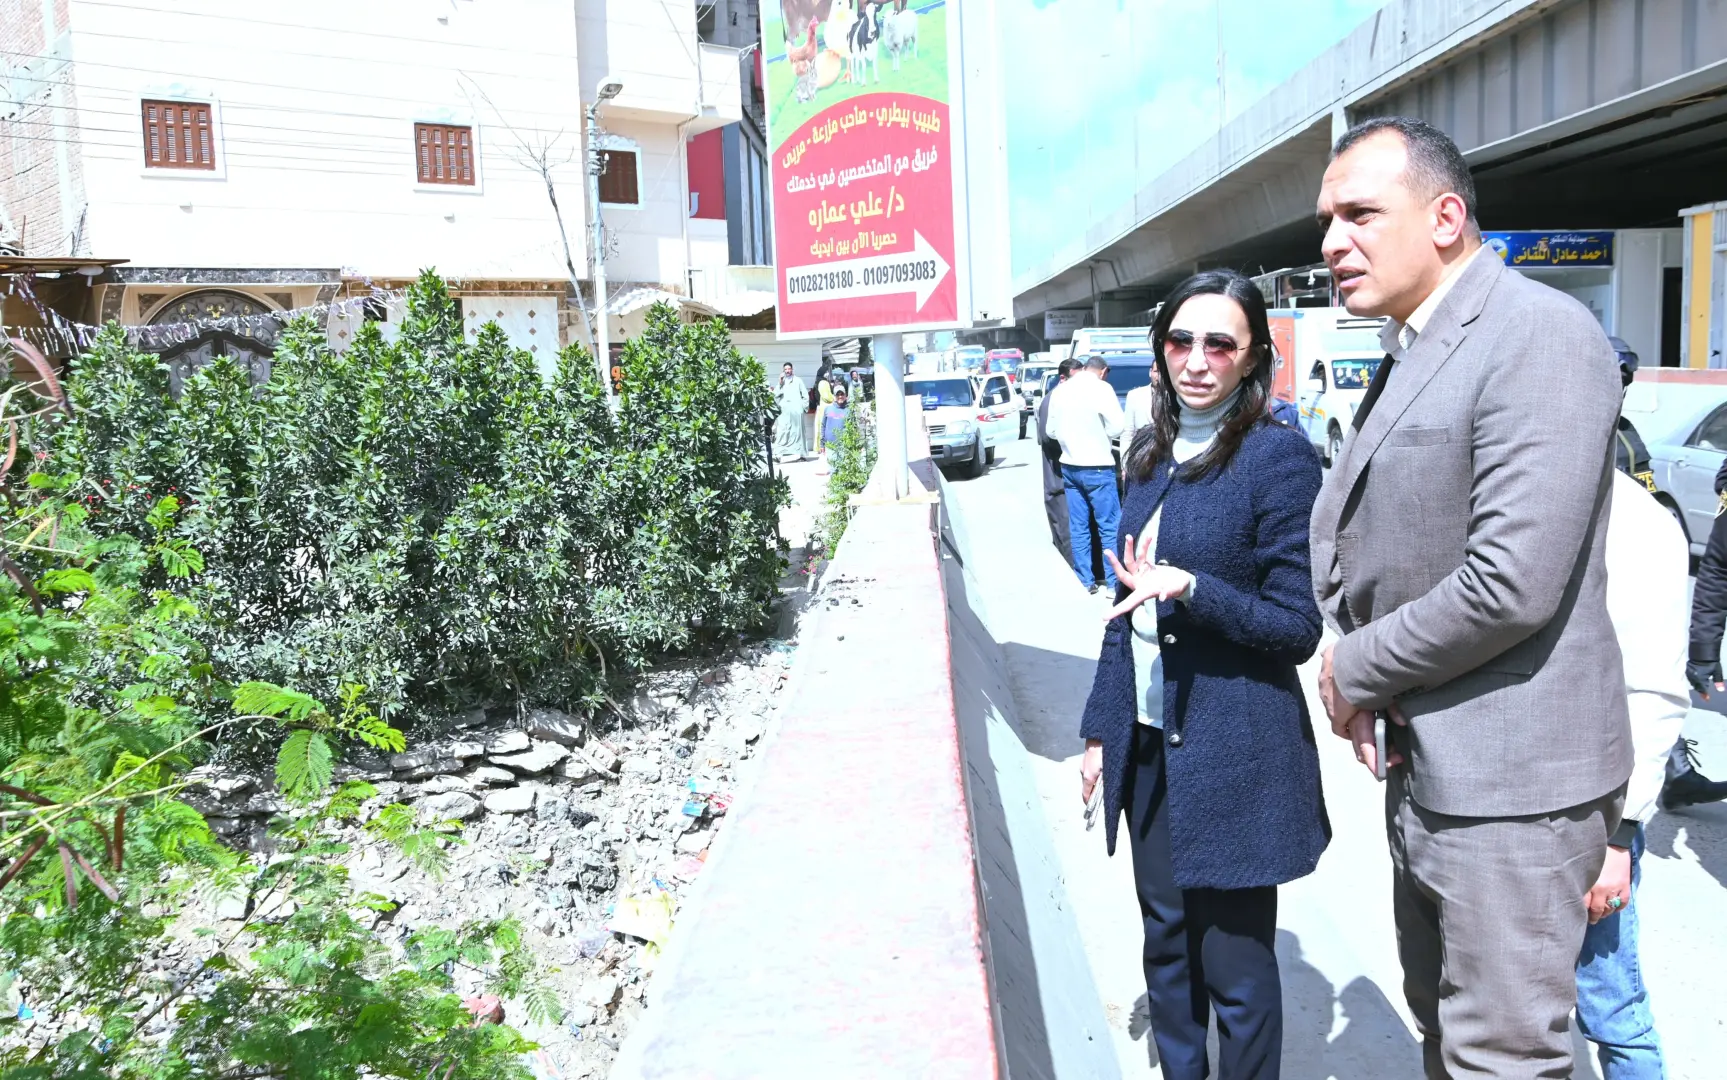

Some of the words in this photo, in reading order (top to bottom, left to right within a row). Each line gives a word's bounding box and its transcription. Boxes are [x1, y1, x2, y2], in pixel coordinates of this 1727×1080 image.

[839, 105, 868, 134] صاحب
[875, 101, 911, 129] بيطري
[912, 109, 941, 134] طبيب
[812, 117, 839, 144] مزرعة
[837, 153, 892, 188] المتخصصين
[893, 154, 909, 177] من
[911, 144, 938, 173] فريق
[786, 172, 816, 193] خدمتك
[817, 167, 836, 191] في
[850, 191, 884, 225] علي
[886, 185, 905, 219] د/
[808, 199, 847, 233] عماره
[836, 239, 850, 257] بين
[870, 230, 897, 251] حصريا
[1580, 244, 1607, 260] أحمد
[1552, 247, 1578, 264] عادل
[789, 269, 854, 294] 01028218180
[863, 259, 936, 286] 01097093083
